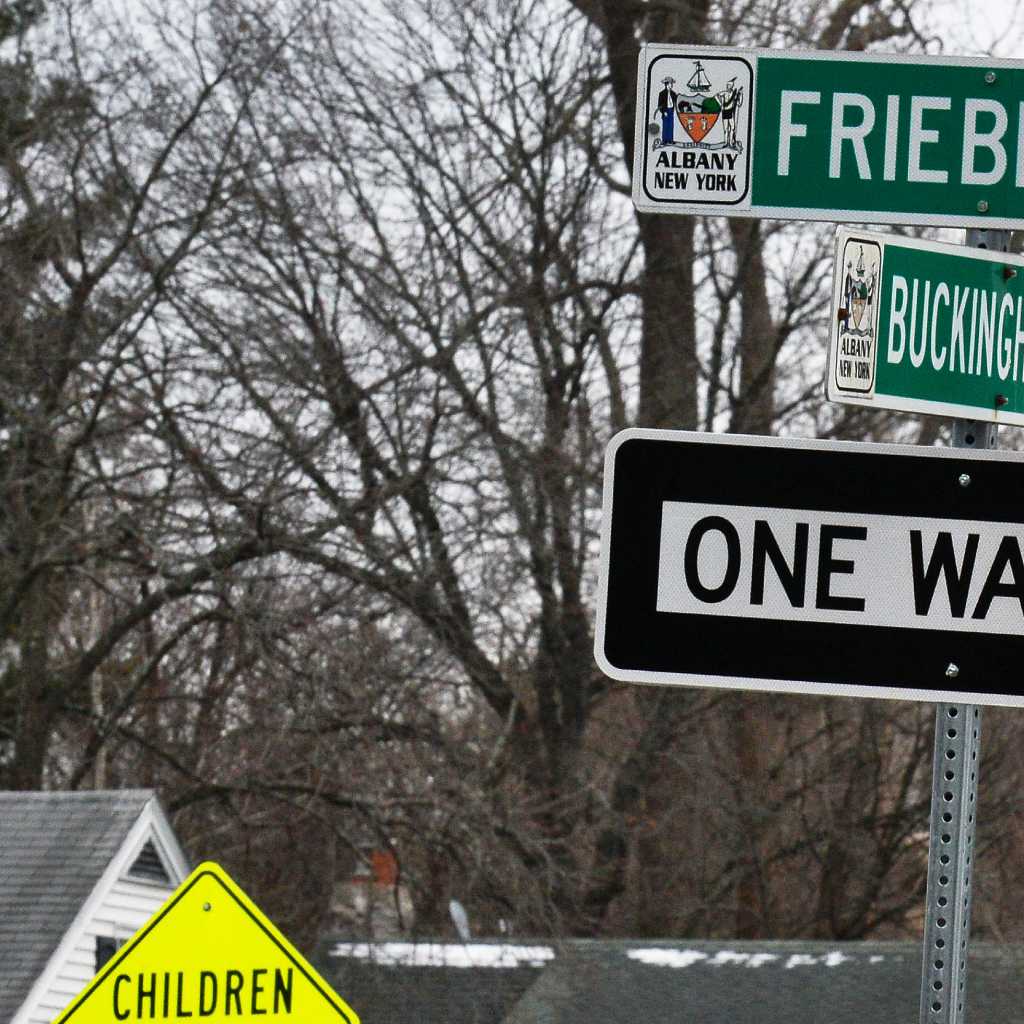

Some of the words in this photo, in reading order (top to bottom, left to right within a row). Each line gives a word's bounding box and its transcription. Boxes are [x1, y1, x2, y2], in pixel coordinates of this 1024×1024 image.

[655, 151, 738, 170] ALBANY
[654, 172, 689, 190] NEW
[695, 173, 737, 192] YORK
[841, 338, 872, 358] ALBANY
[839, 359, 852, 378] NEW
[854, 361, 870, 380] YORK
[683, 515, 868, 613] ONE
[112, 967, 294, 1021] CHILDREN
